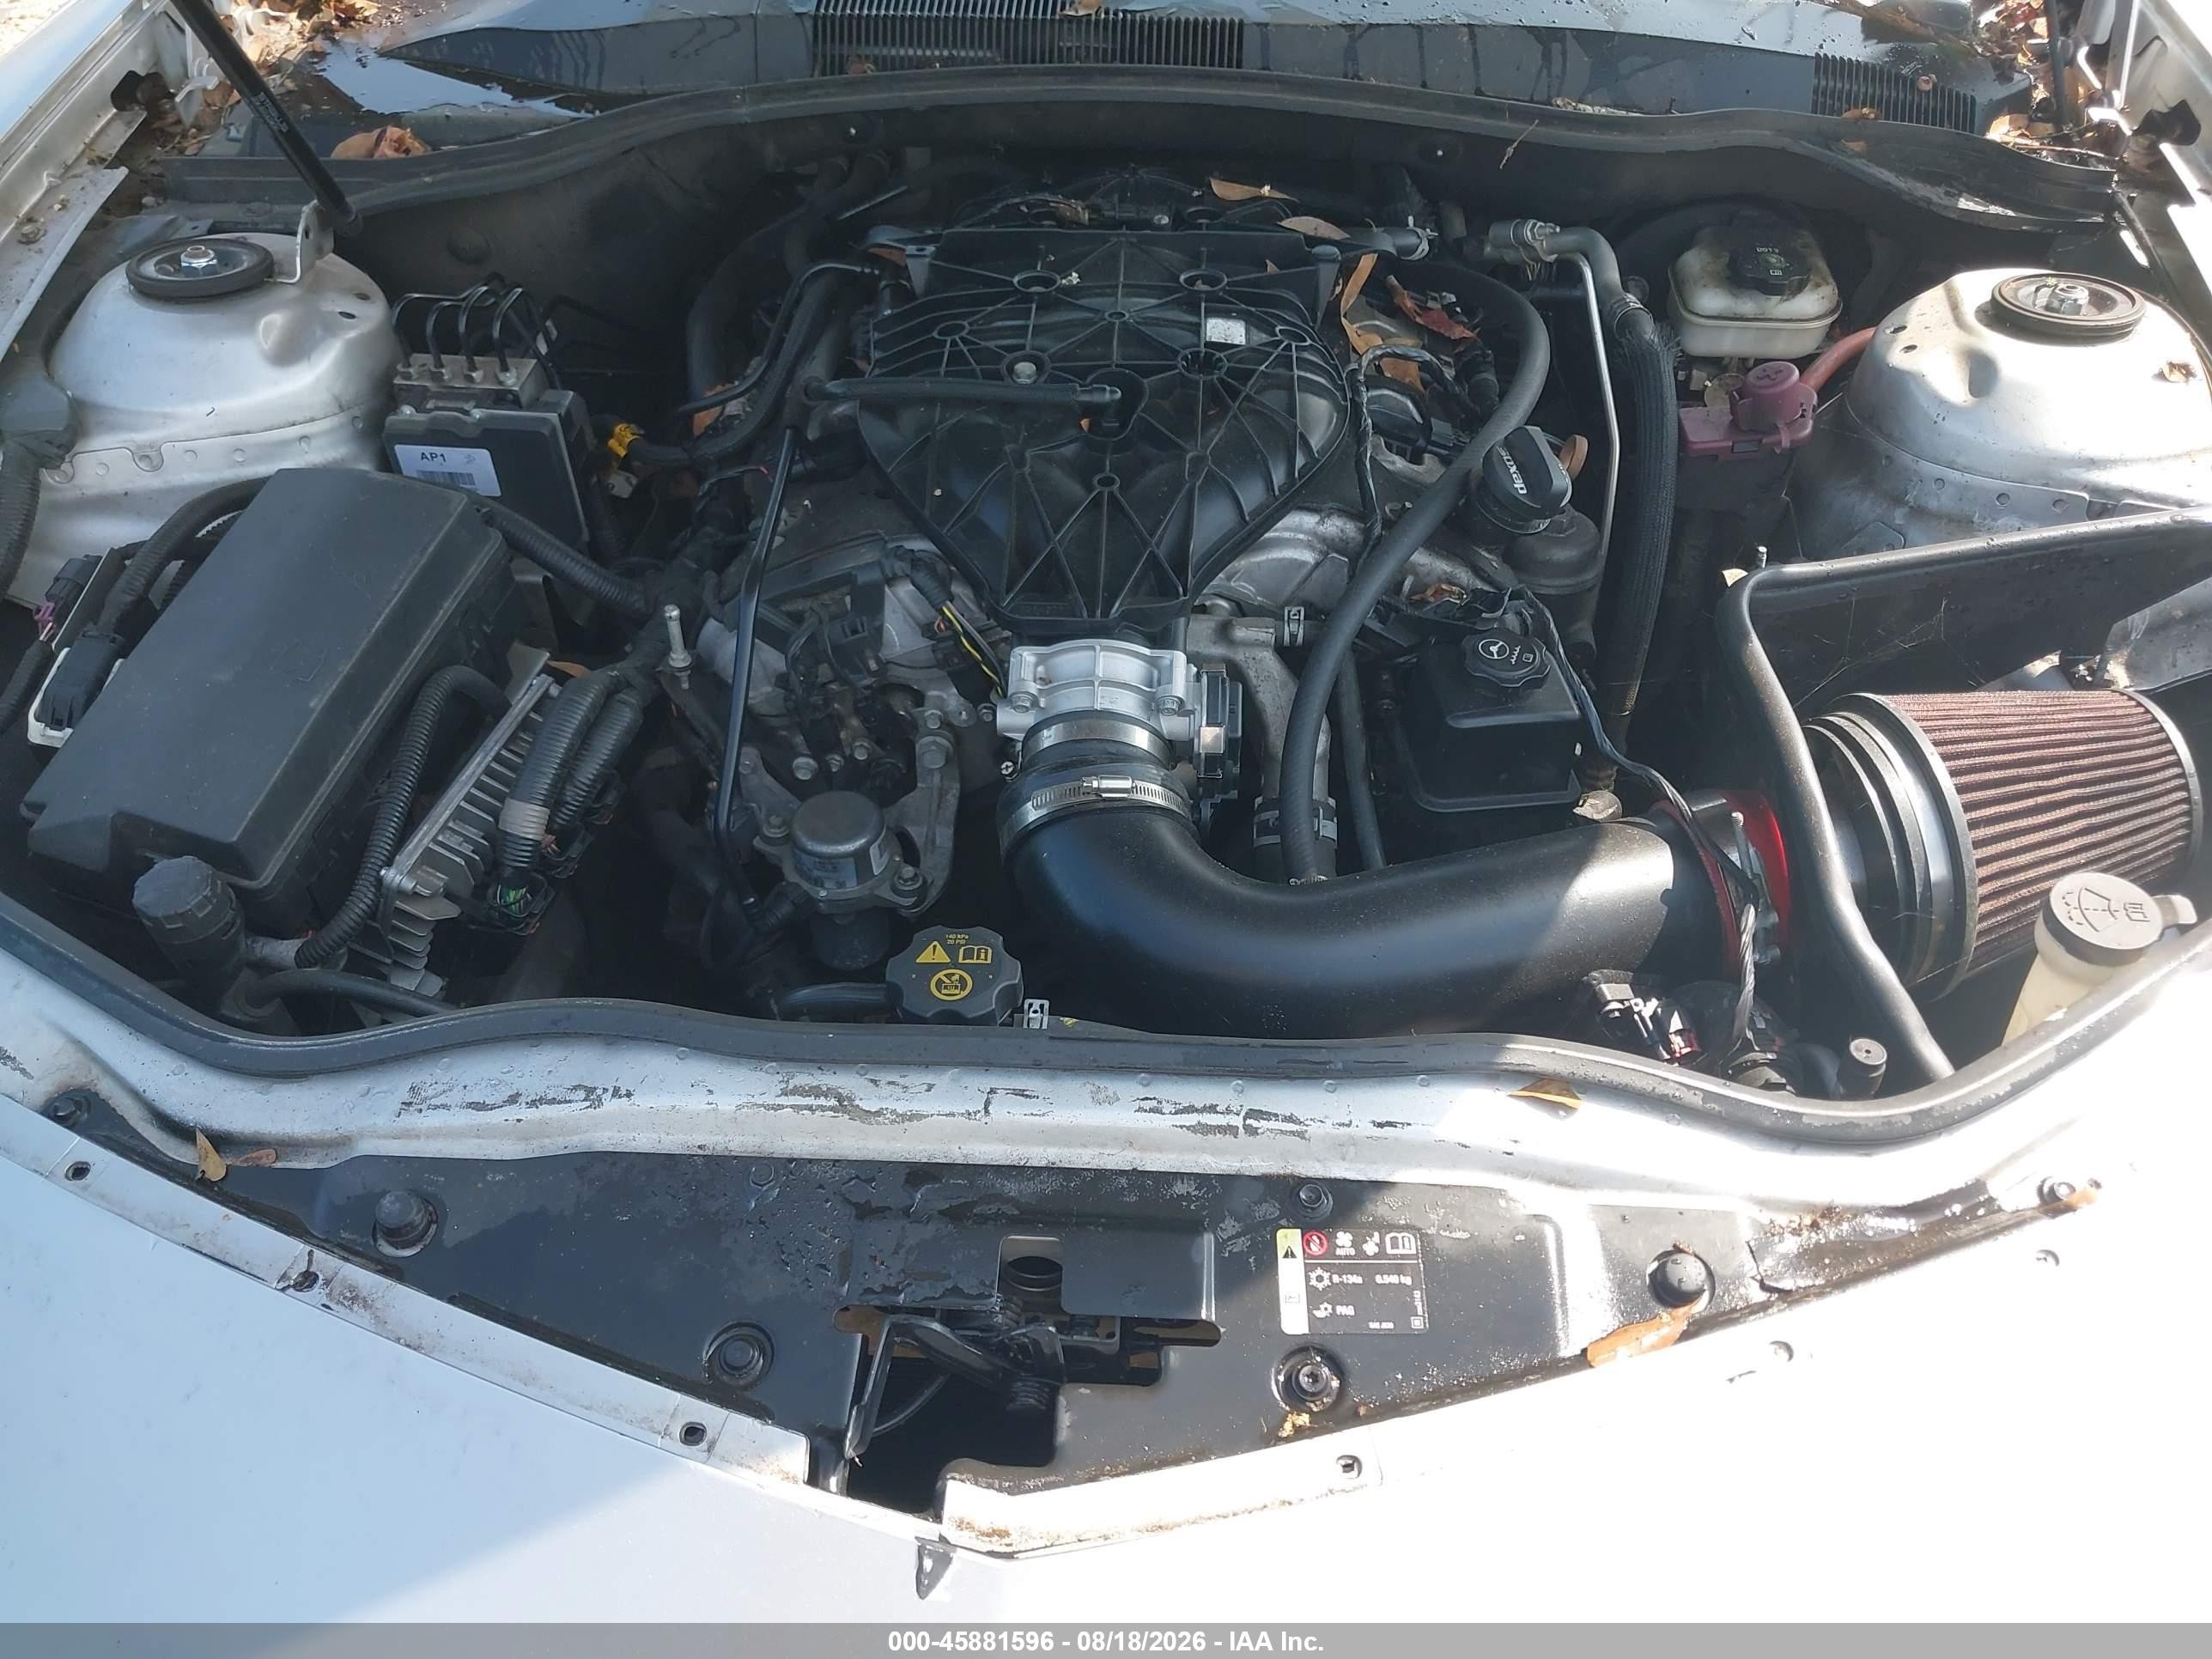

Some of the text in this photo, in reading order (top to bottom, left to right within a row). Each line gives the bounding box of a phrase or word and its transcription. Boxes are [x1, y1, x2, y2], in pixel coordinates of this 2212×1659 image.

[421, 452, 447, 464] AP1
[1497, 446, 1528, 495] dexos
[1335, 1247, 1356, 1256] AUTO
